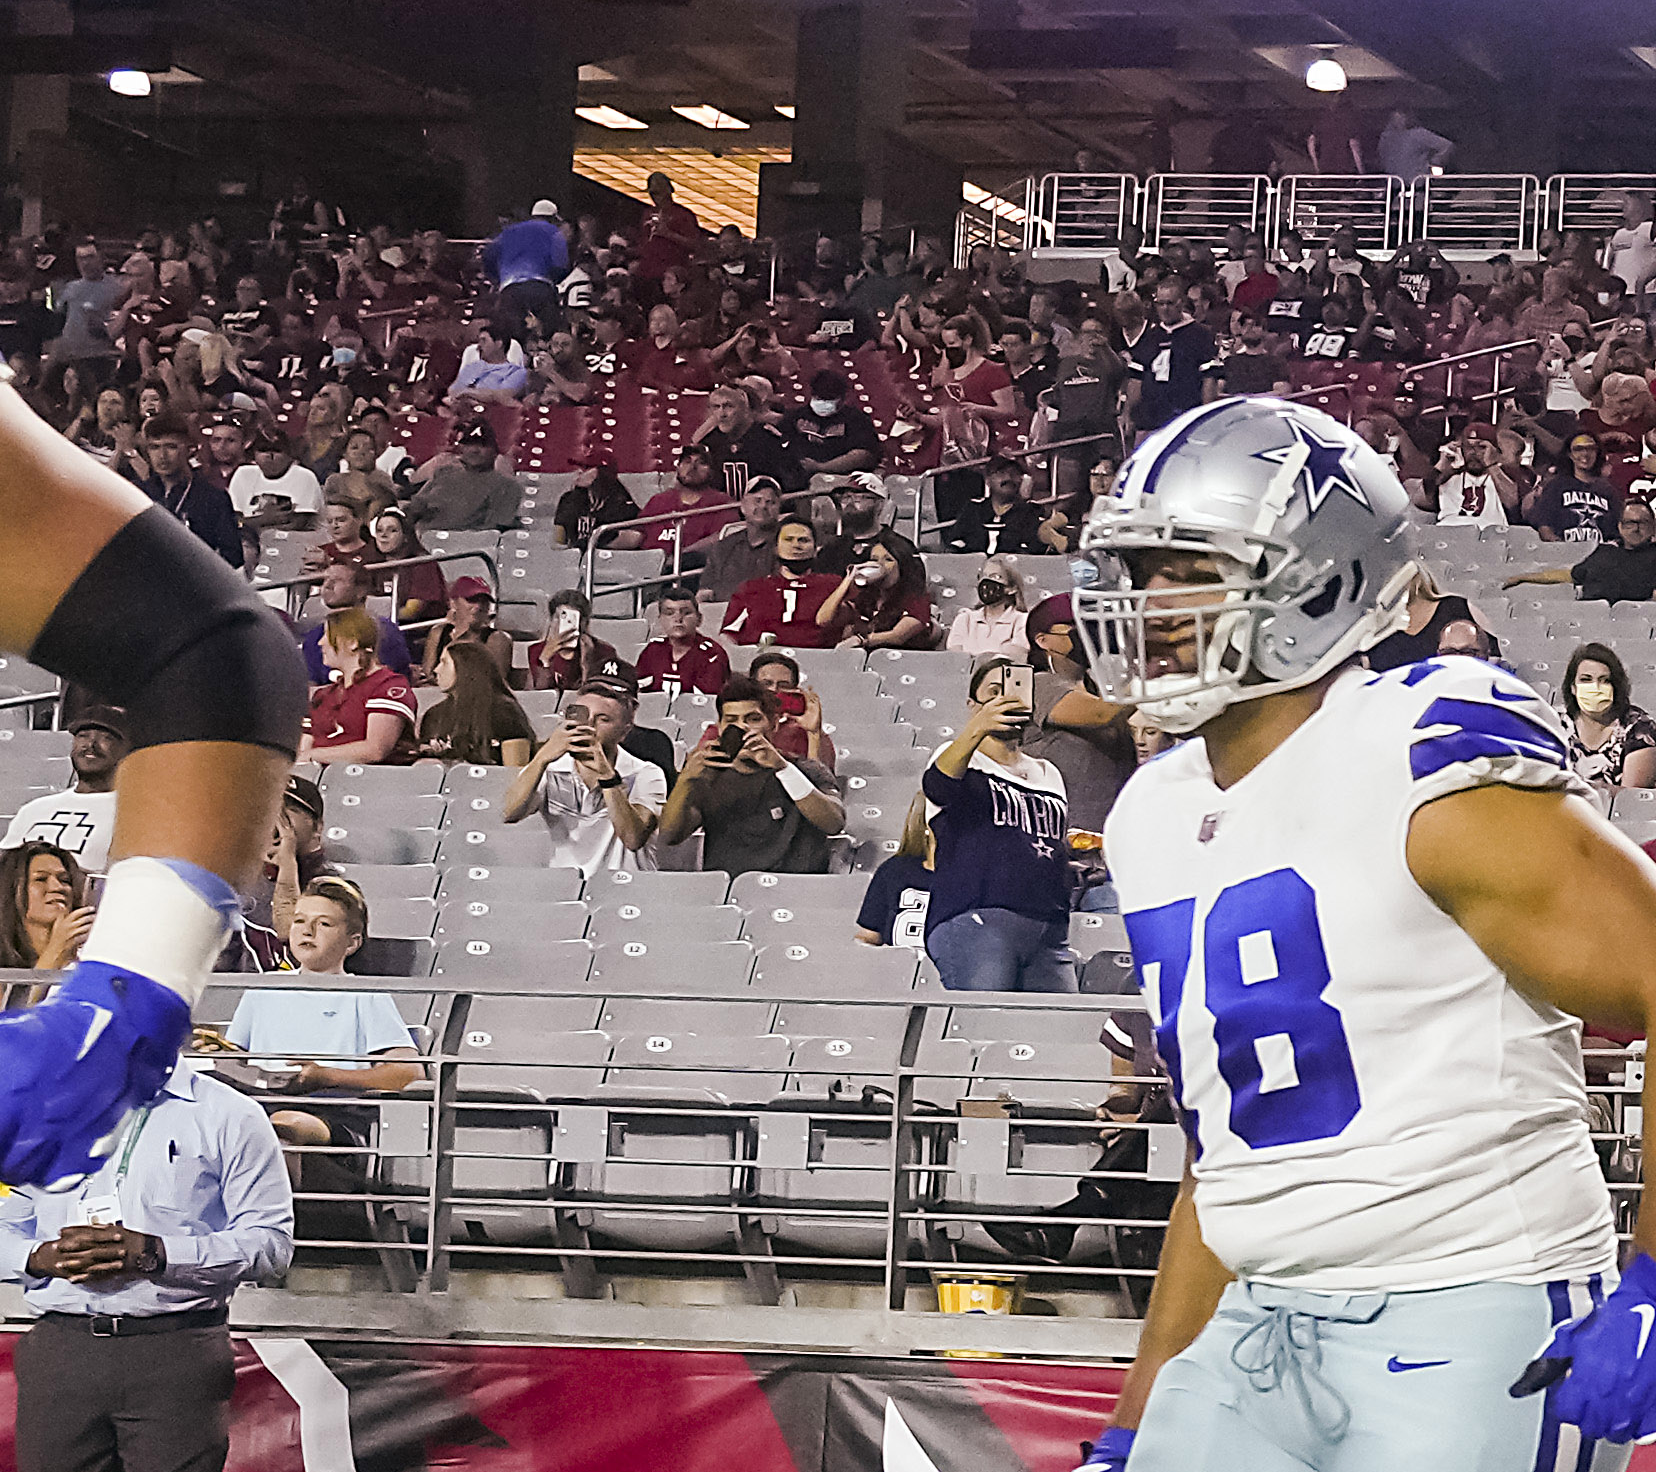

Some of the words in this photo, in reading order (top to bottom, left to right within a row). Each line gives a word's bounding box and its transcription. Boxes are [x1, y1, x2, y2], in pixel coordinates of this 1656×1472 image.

[1149, 349, 1169, 383] 4
[1562, 491, 1611, 512] DALLAS
[781, 589, 795, 623] 1
[1123, 867, 1363, 1161] 78
